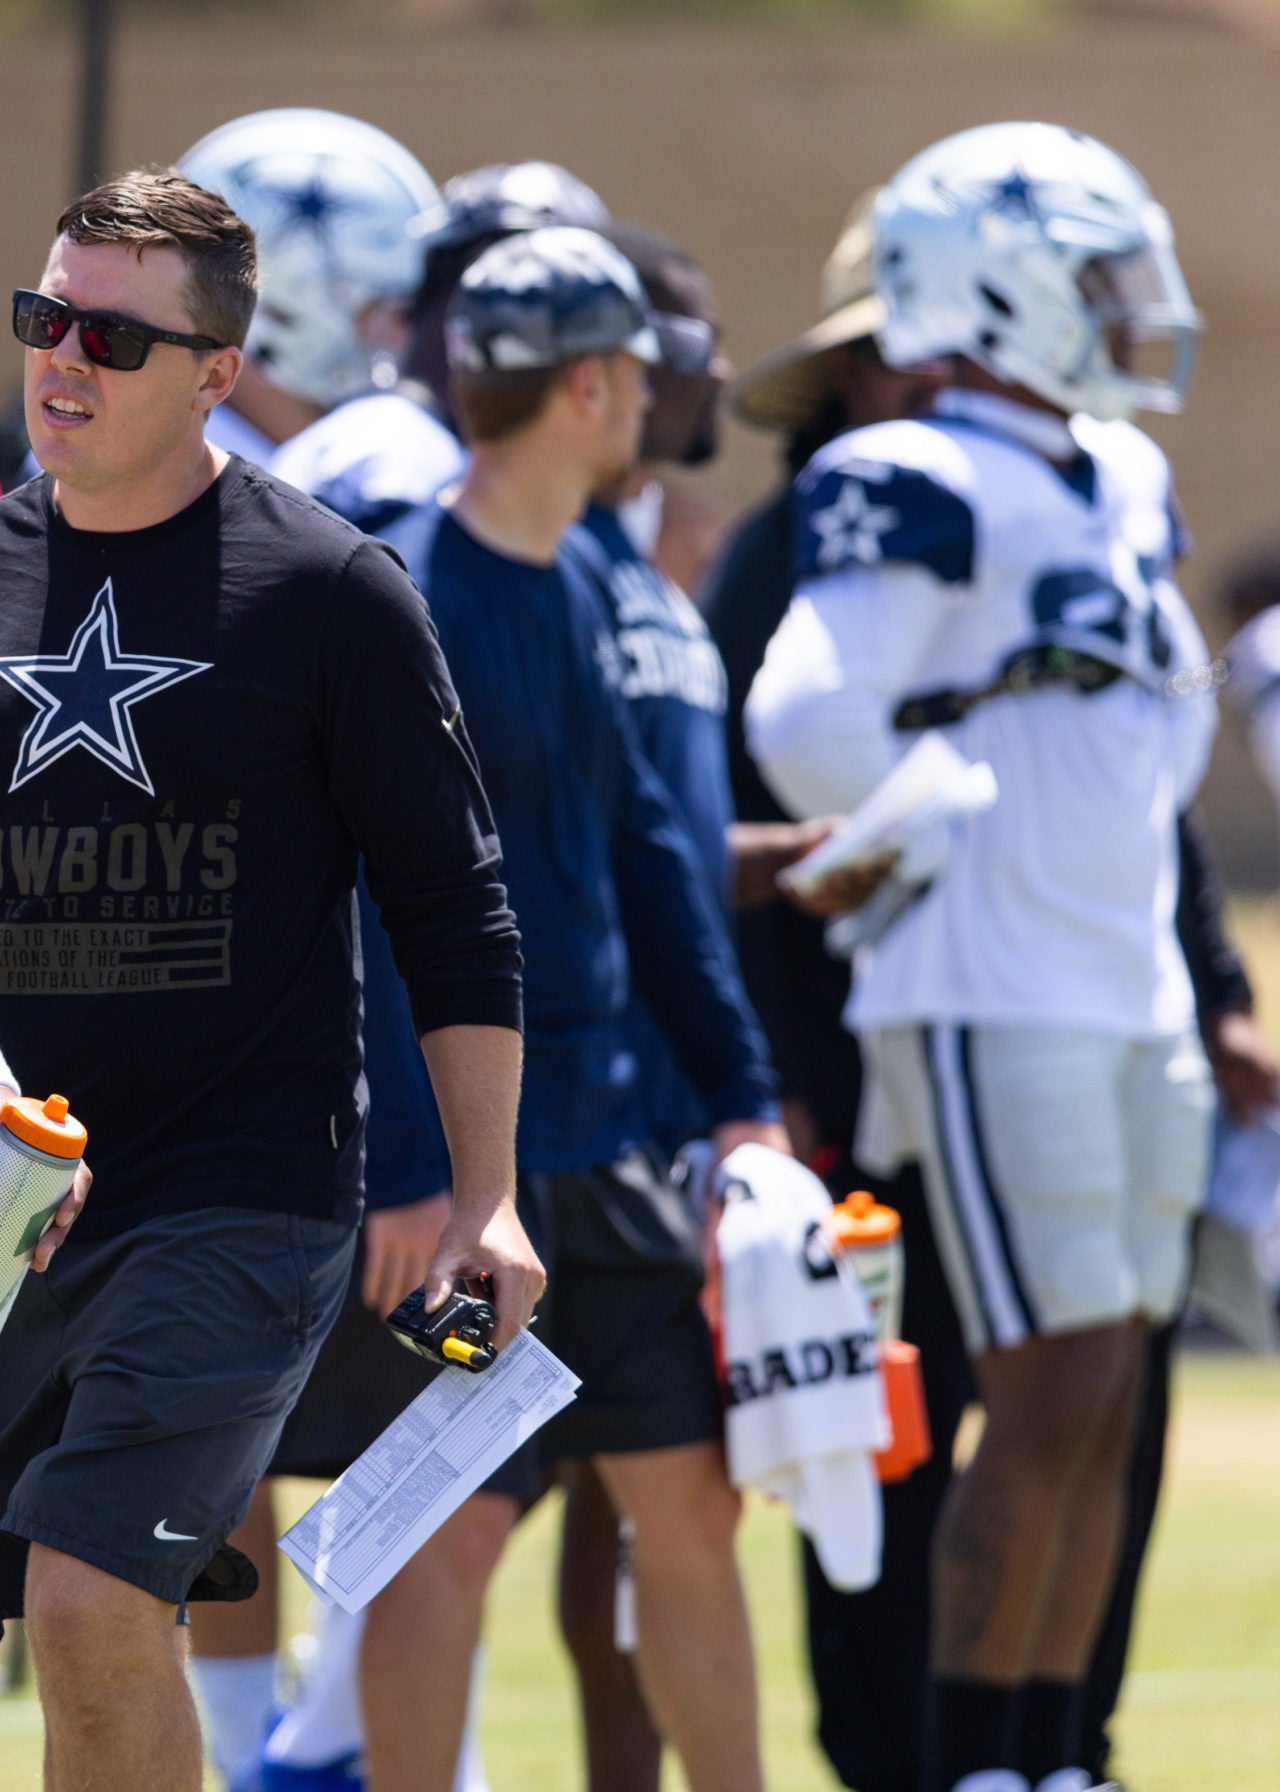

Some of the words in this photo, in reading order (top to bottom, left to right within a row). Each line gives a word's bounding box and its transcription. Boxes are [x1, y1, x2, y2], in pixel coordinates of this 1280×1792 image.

[42, 896, 79, 918] TO
[100, 892, 233, 919] SERVICE
[23, 929, 44, 946] TO
[53, 929, 81, 946] THE
[90, 929, 145, 946] EXACT
[59, 950, 78, 967] OF
[87, 950, 116, 967] THE
[7, 971, 89, 988] FOOTBALL
